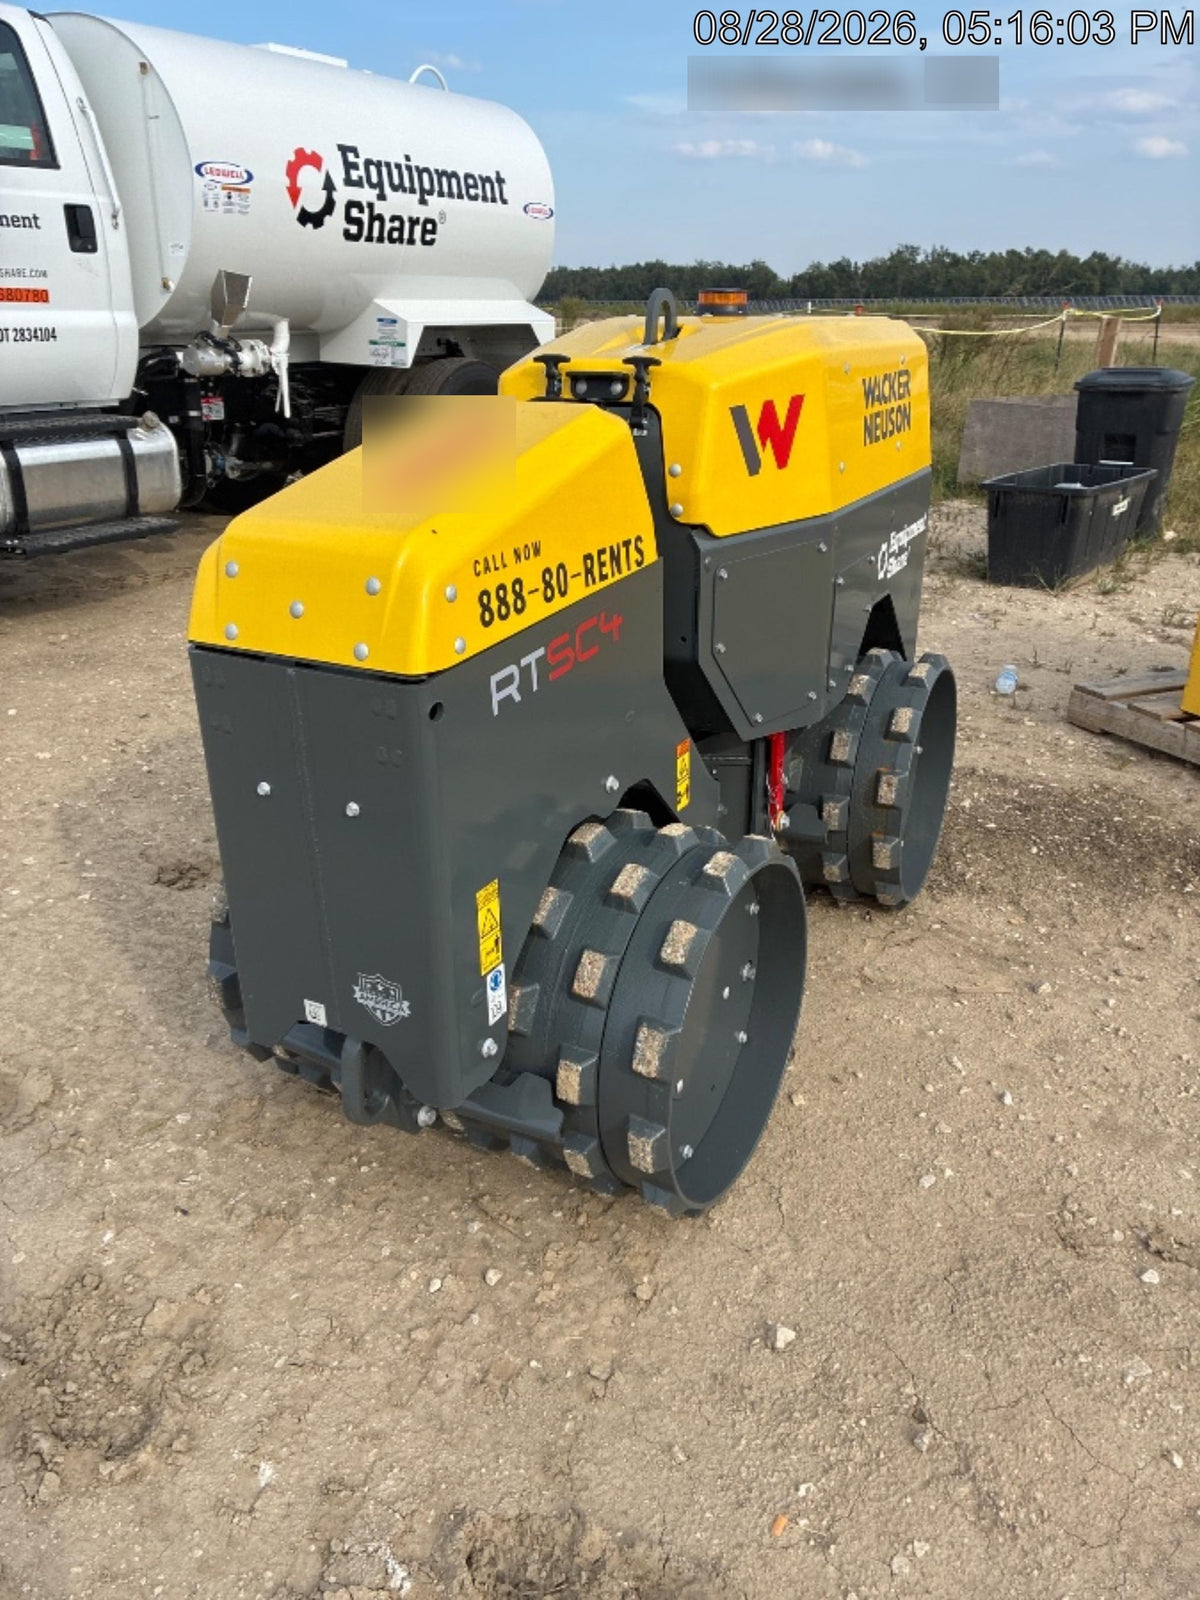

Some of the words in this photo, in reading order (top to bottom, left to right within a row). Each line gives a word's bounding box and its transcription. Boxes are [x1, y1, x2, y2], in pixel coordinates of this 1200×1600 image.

[337, 143, 508, 206] Equipment
[12, 326, 57, 343] 2834104
[862, 369, 911, 410] WACKER
[863, 402, 911, 447] NEUSON
[473, 551, 507, 577] CALL
[513, 540, 541, 564] NOW
[478, 534, 645, 628] 888-80-RENTS
[490, 611, 623, 716] RTSC4
